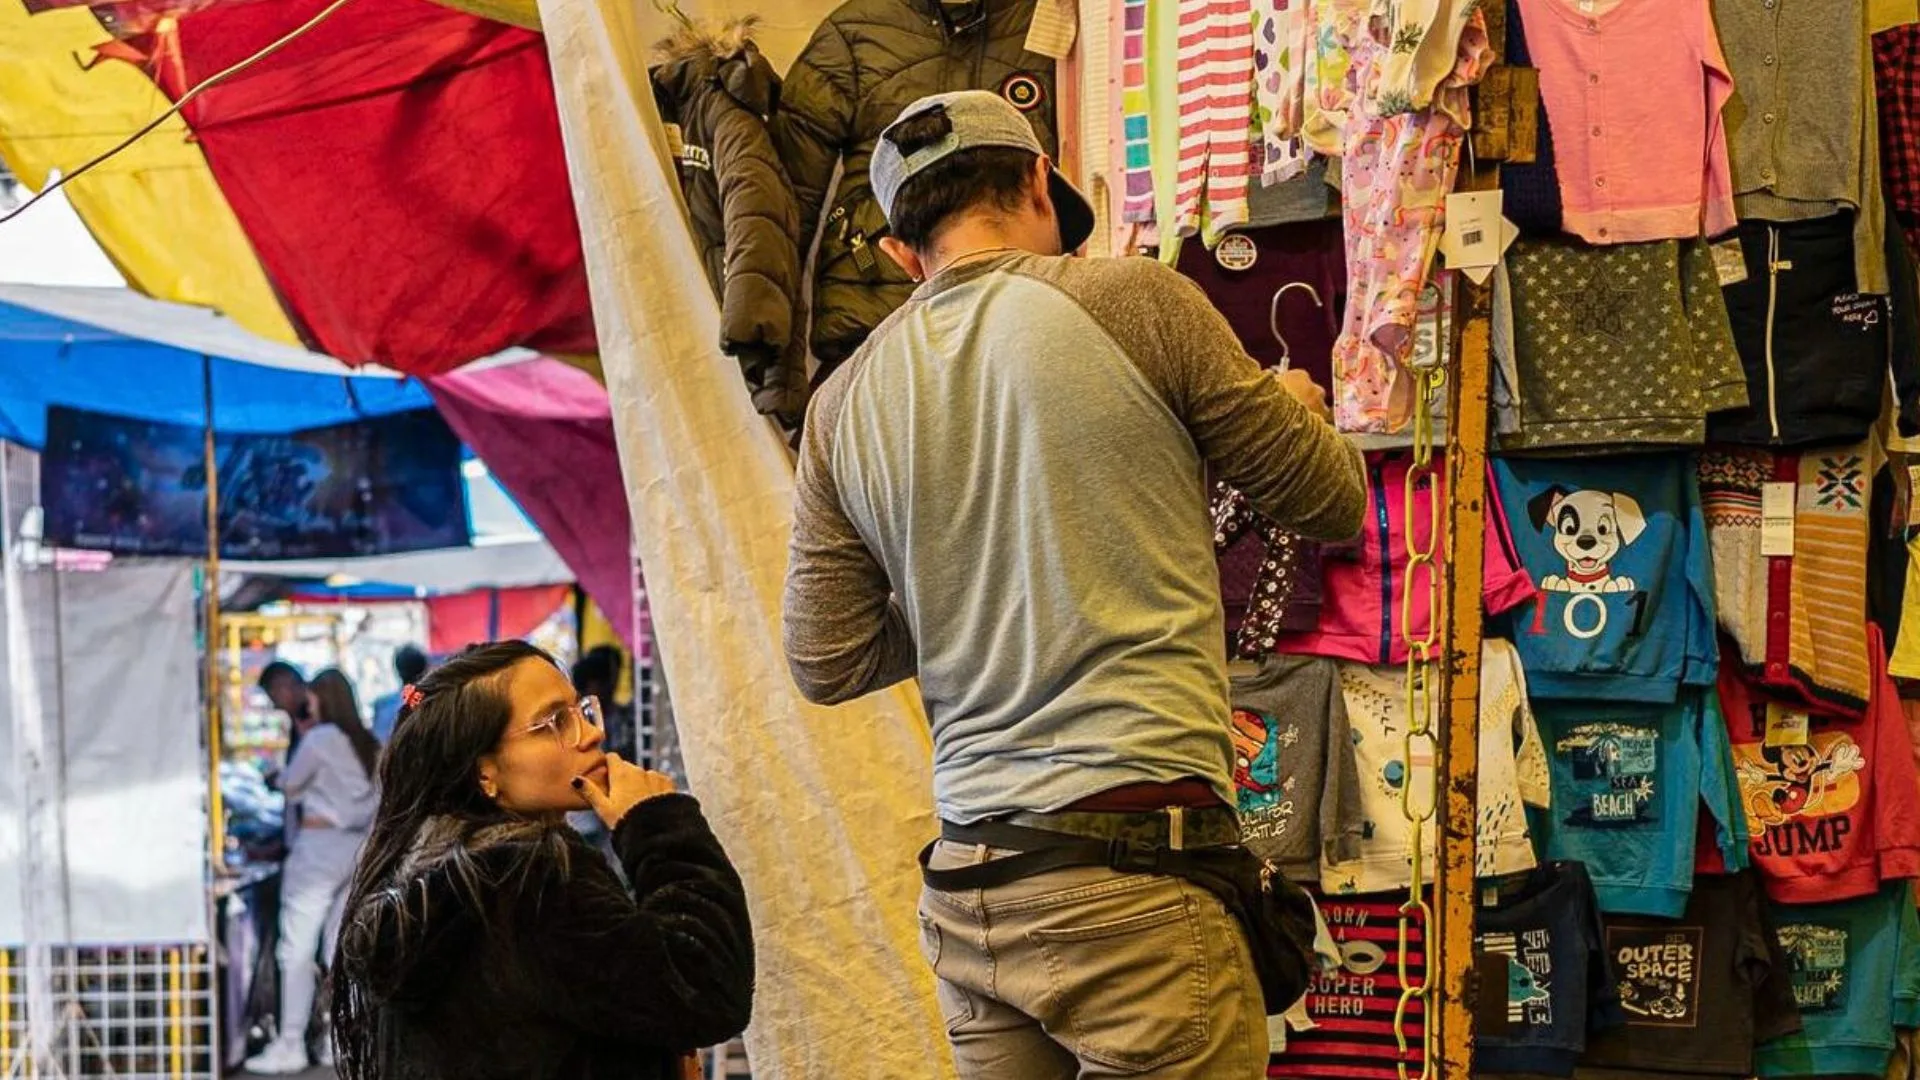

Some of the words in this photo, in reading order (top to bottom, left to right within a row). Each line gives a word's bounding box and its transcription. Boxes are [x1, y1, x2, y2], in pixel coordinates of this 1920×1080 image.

[1592, 792, 1634, 817] BEACH
[1240, 818, 1288, 843] BATTLE
[1753, 814, 1851, 857] JUMP
[1336, 926, 1345, 941] A
[1618, 943, 1694, 965] OUTER
[1625, 961, 1693, 983] SPACE
[1307, 974, 1376, 996] SUPER
[1314, 996, 1364, 1016] HERO
